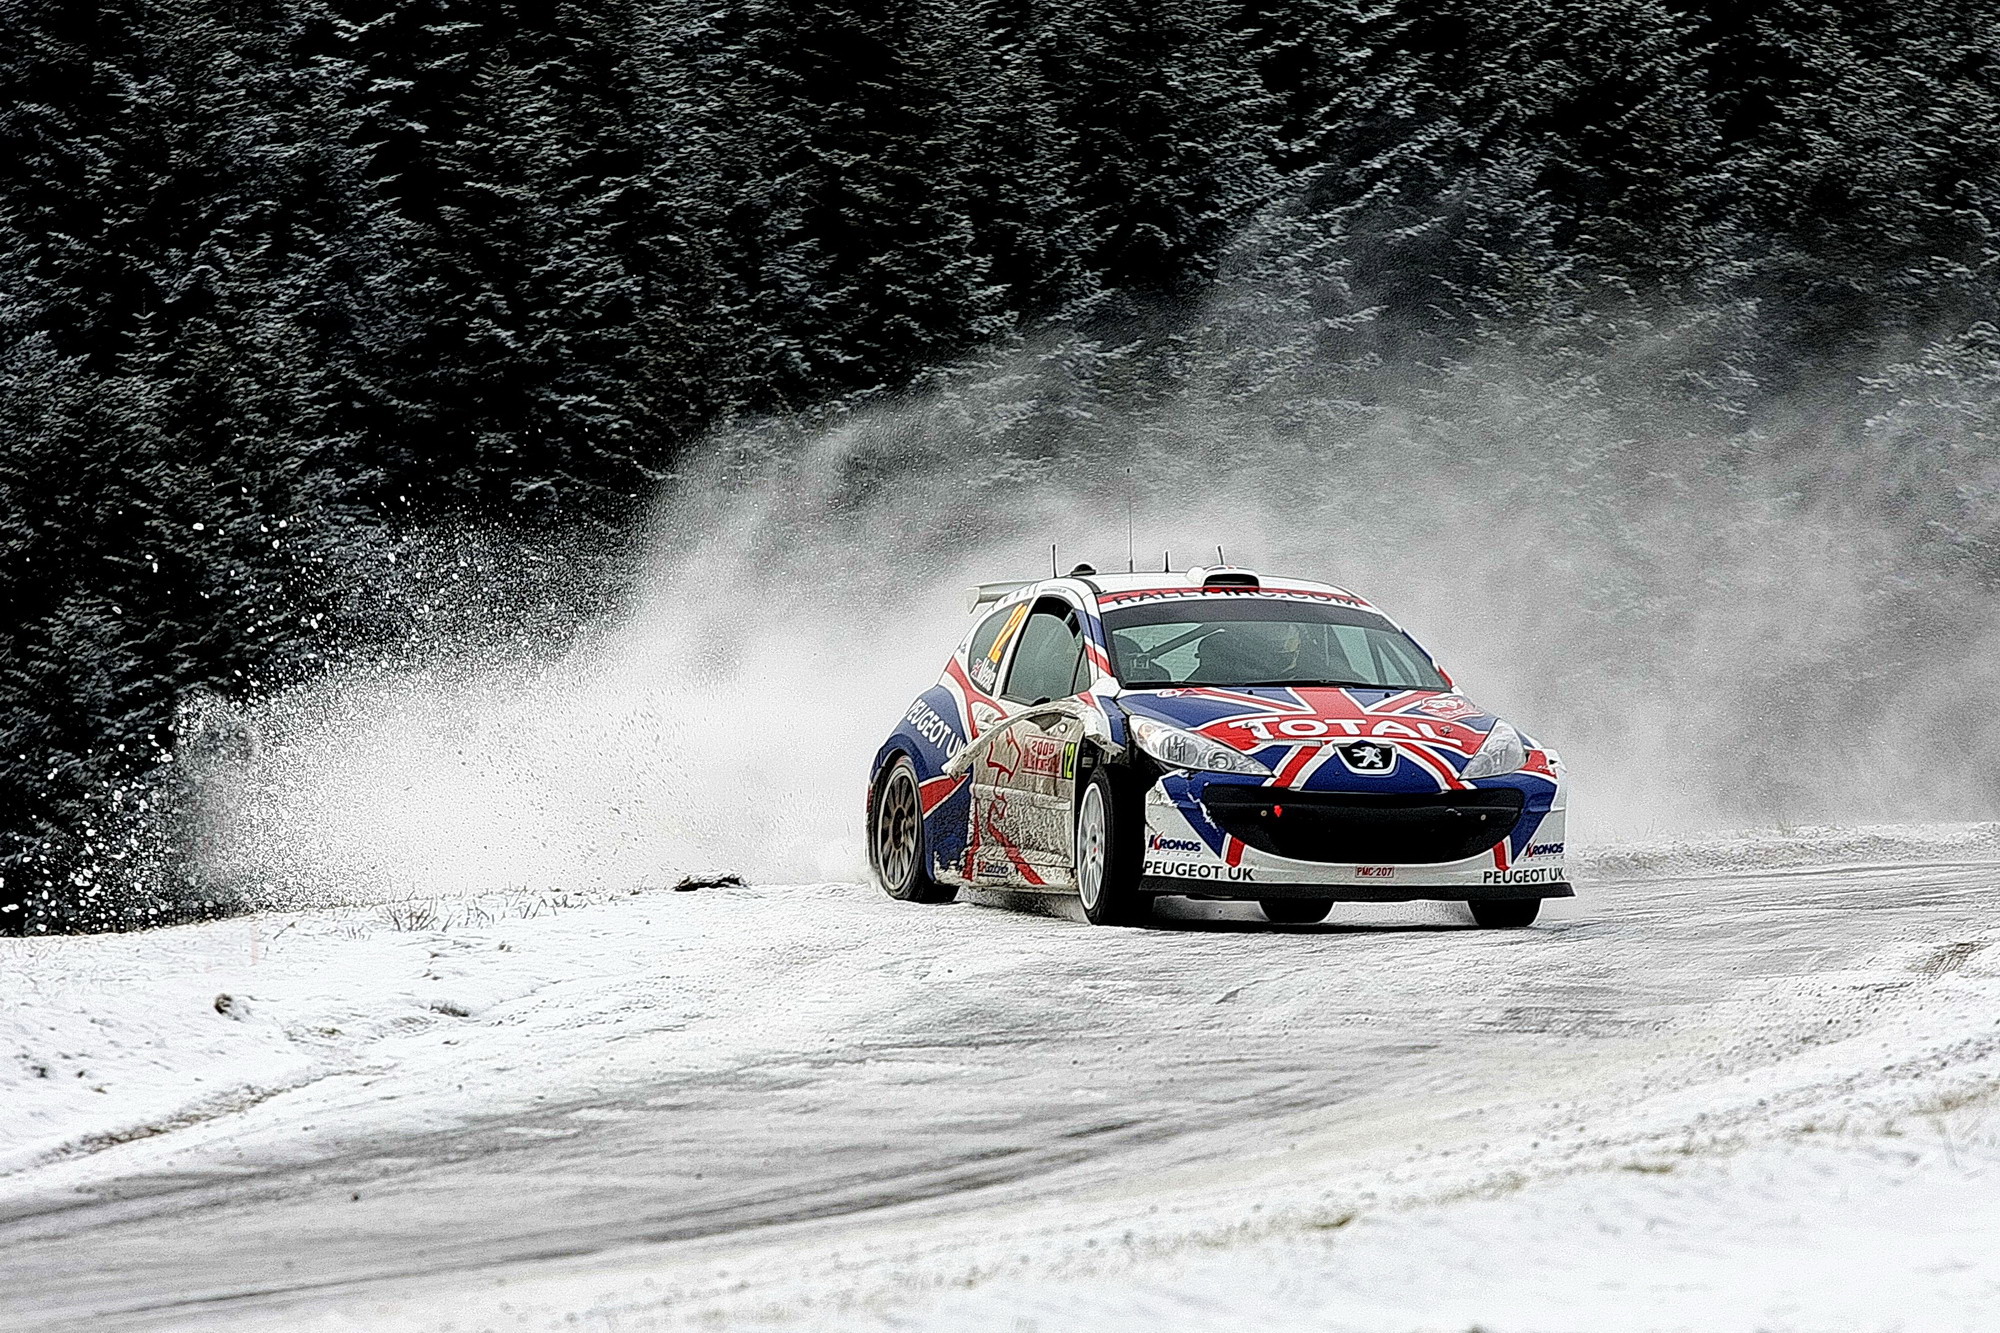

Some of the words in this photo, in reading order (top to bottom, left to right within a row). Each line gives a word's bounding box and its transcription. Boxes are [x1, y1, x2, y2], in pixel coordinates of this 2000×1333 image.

[906, 699, 952, 749] PEUGEOT
[1228, 716, 1463, 747] TOTAL
[1031, 740, 1055, 756] 2009
[1064, 742, 1074, 778] 12
[1148, 831, 1202, 852] KRONOS
[1524, 839, 1565, 858] KRONOS
[1143, 860, 1223, 880] PEUGEOT
[1227, 866, 1255, 881] UK
[1483, 868, 1547, 884] PEUGEOT
[1548, 867, 1566, 881] UK
